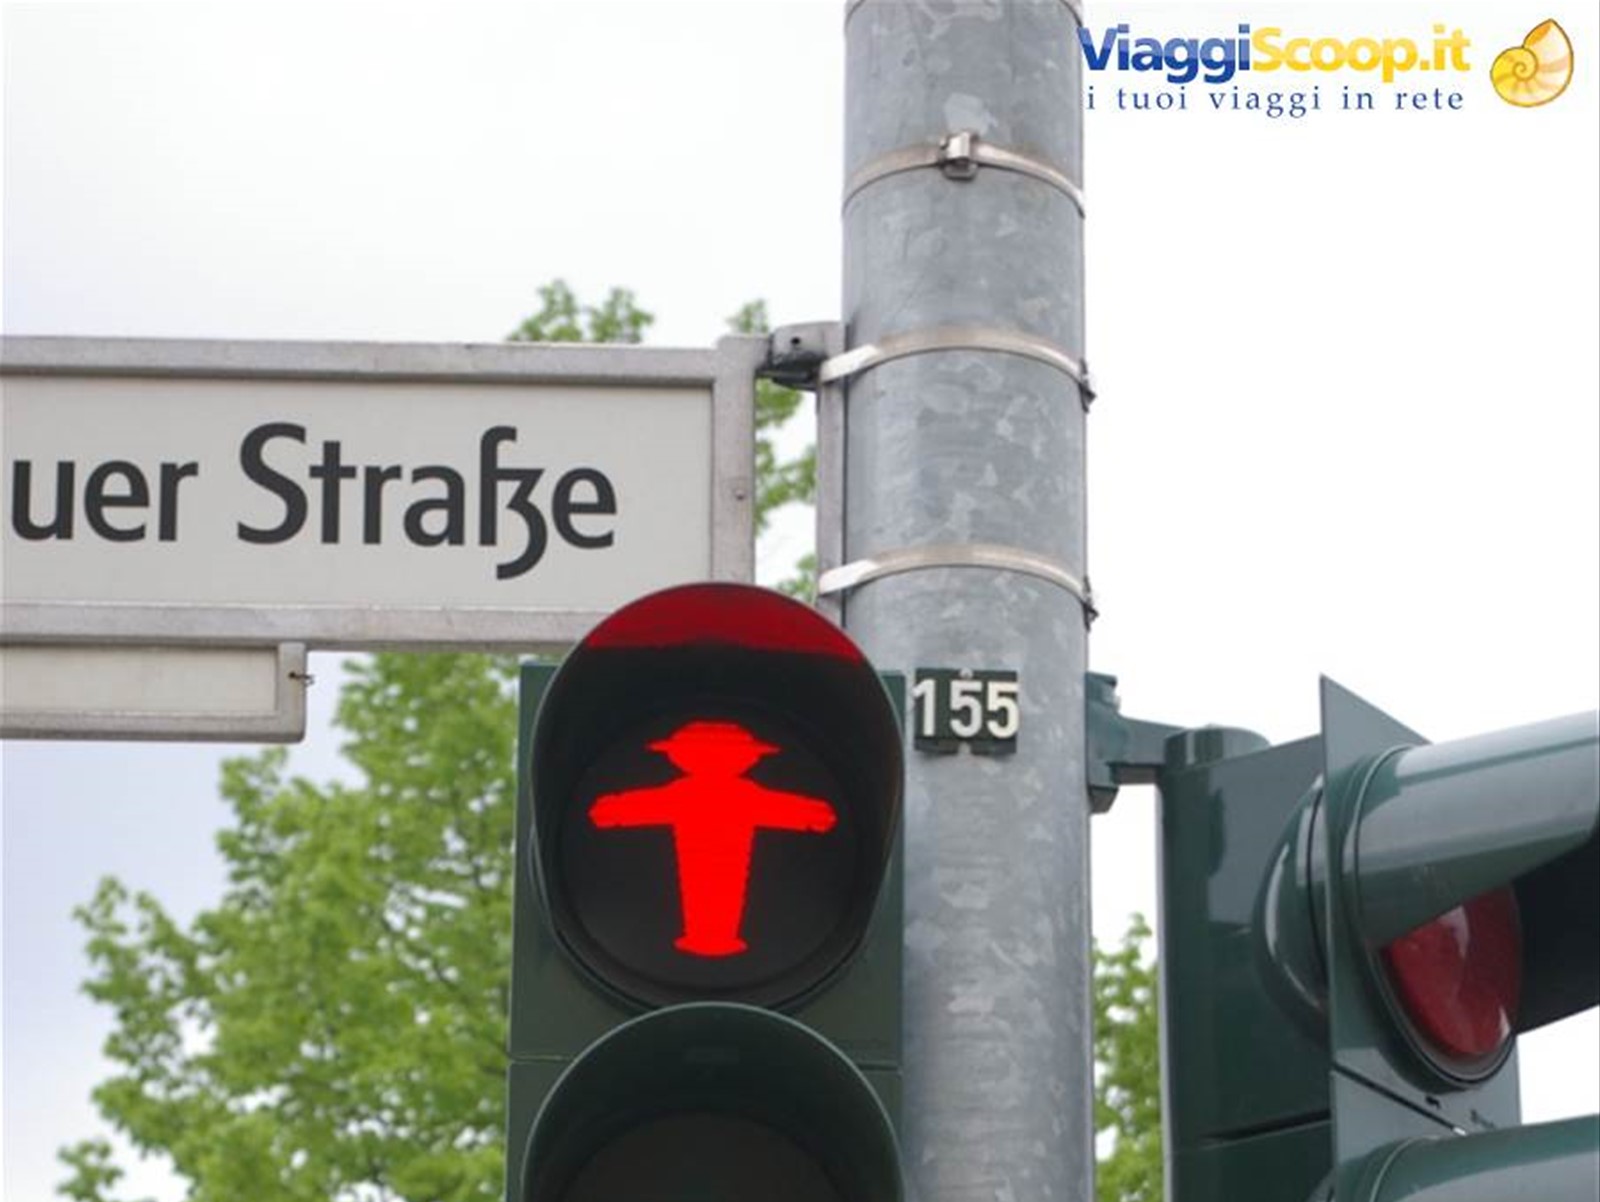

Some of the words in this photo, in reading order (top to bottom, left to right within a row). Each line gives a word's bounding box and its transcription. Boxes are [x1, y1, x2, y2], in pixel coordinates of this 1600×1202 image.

[11, 459, 199, 543] uer
[237, 422, 618, 580] Straße
[912, 678, 1020, 739] 155
